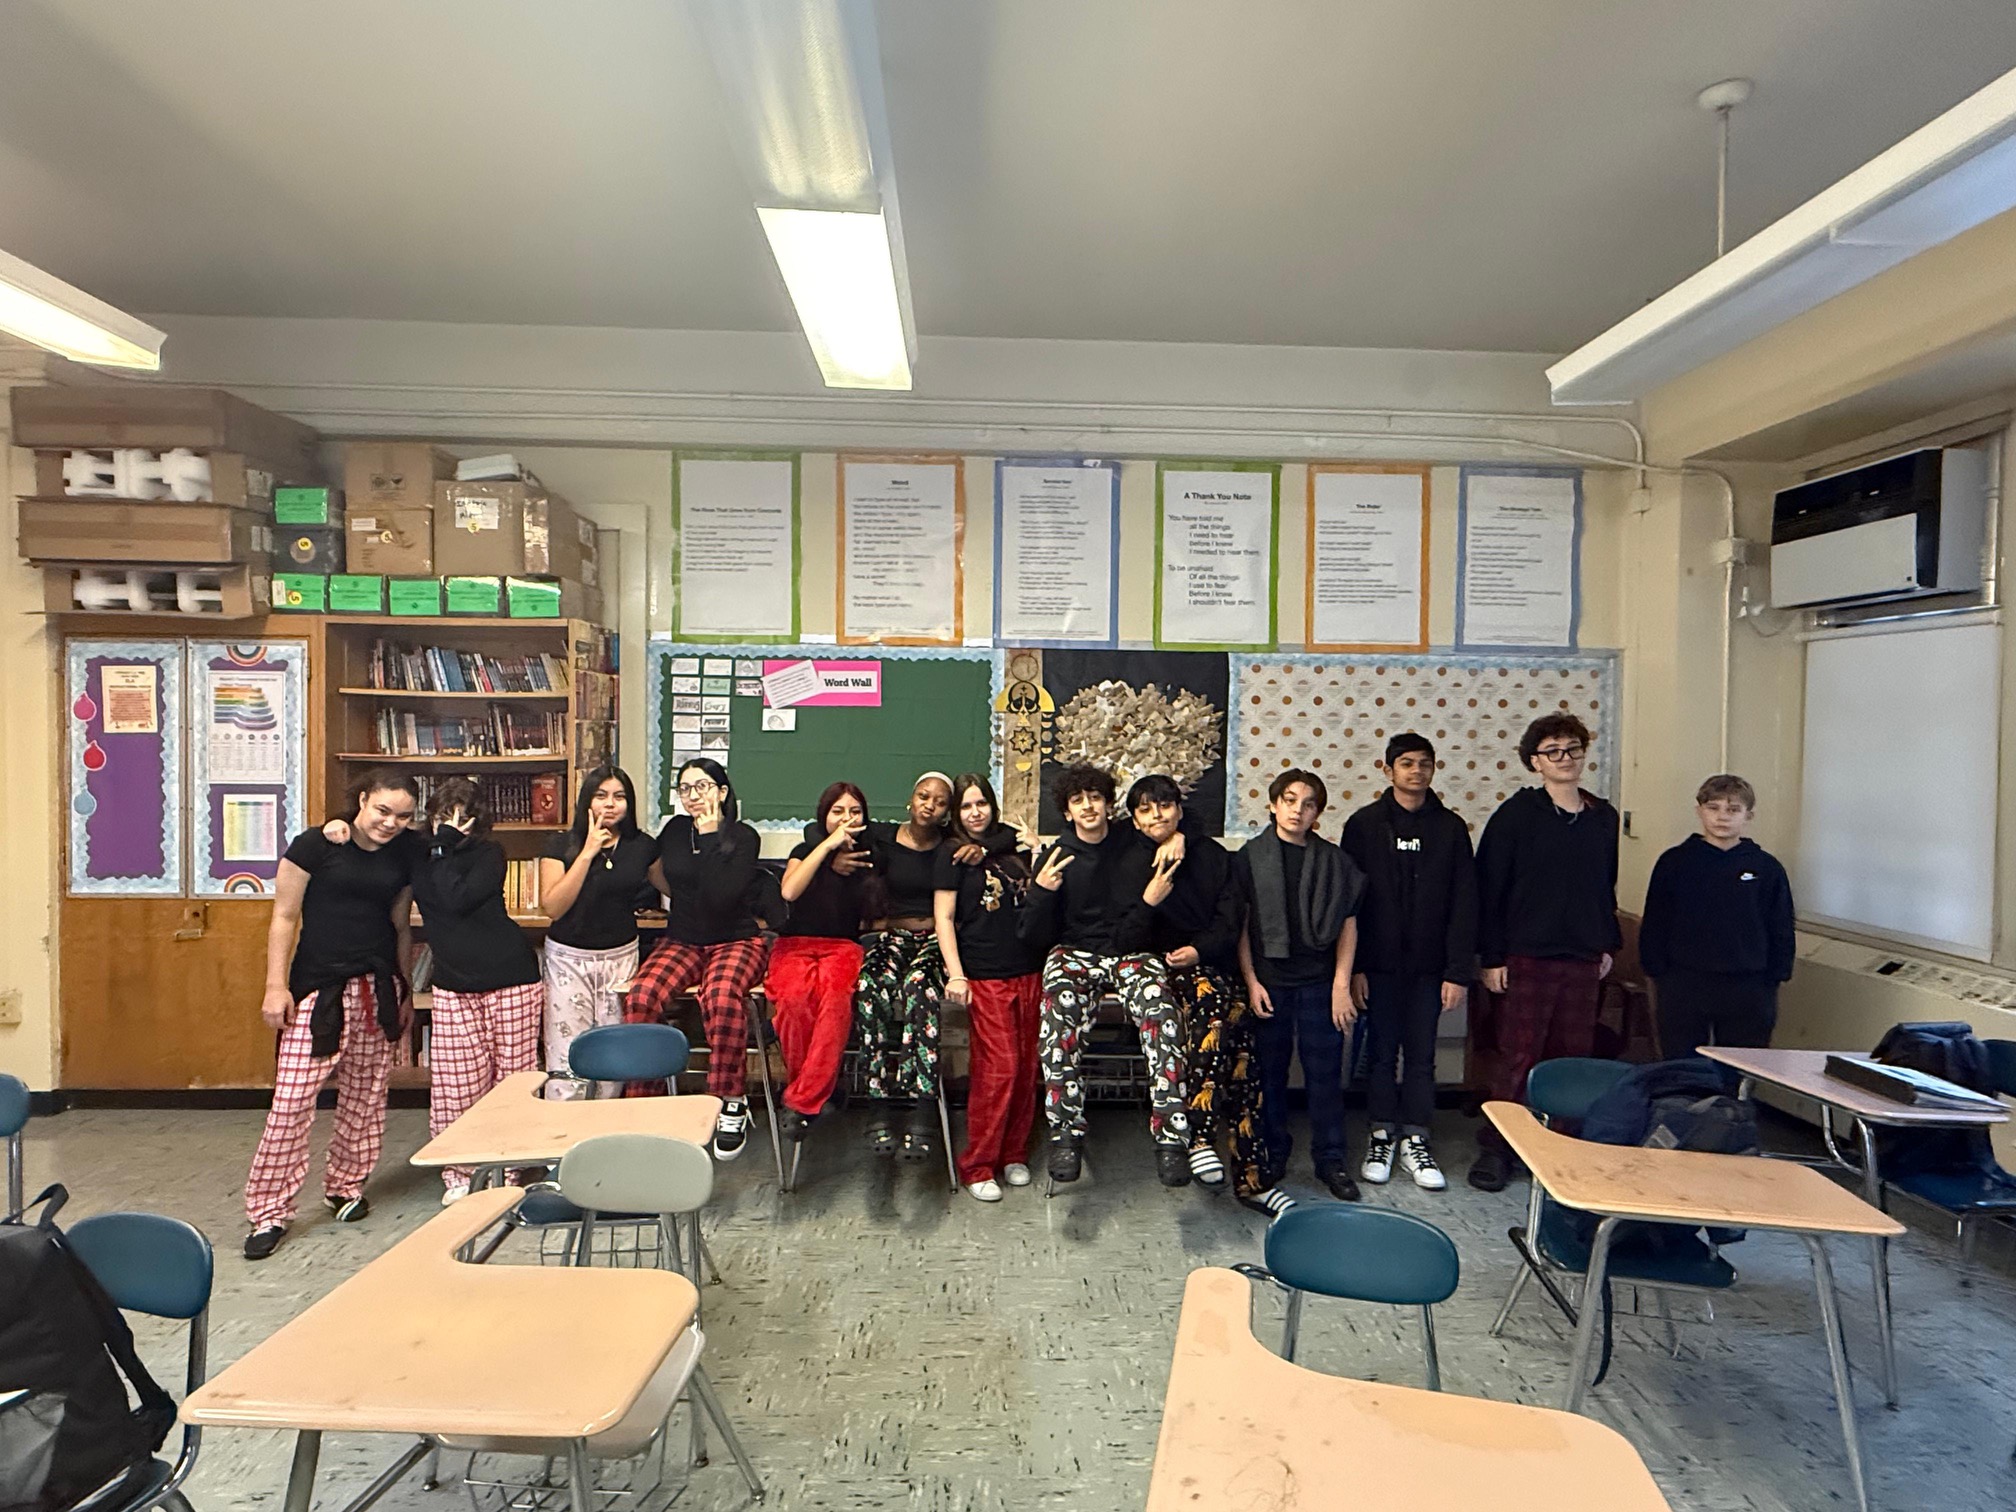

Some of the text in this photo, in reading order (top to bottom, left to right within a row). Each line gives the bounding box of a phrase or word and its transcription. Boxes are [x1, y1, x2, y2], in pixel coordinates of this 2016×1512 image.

[1184, 492, 1190, 500] A
[1191, 492, 1215, 500] Thank
[824, 678, 873, 687] Word Wall
